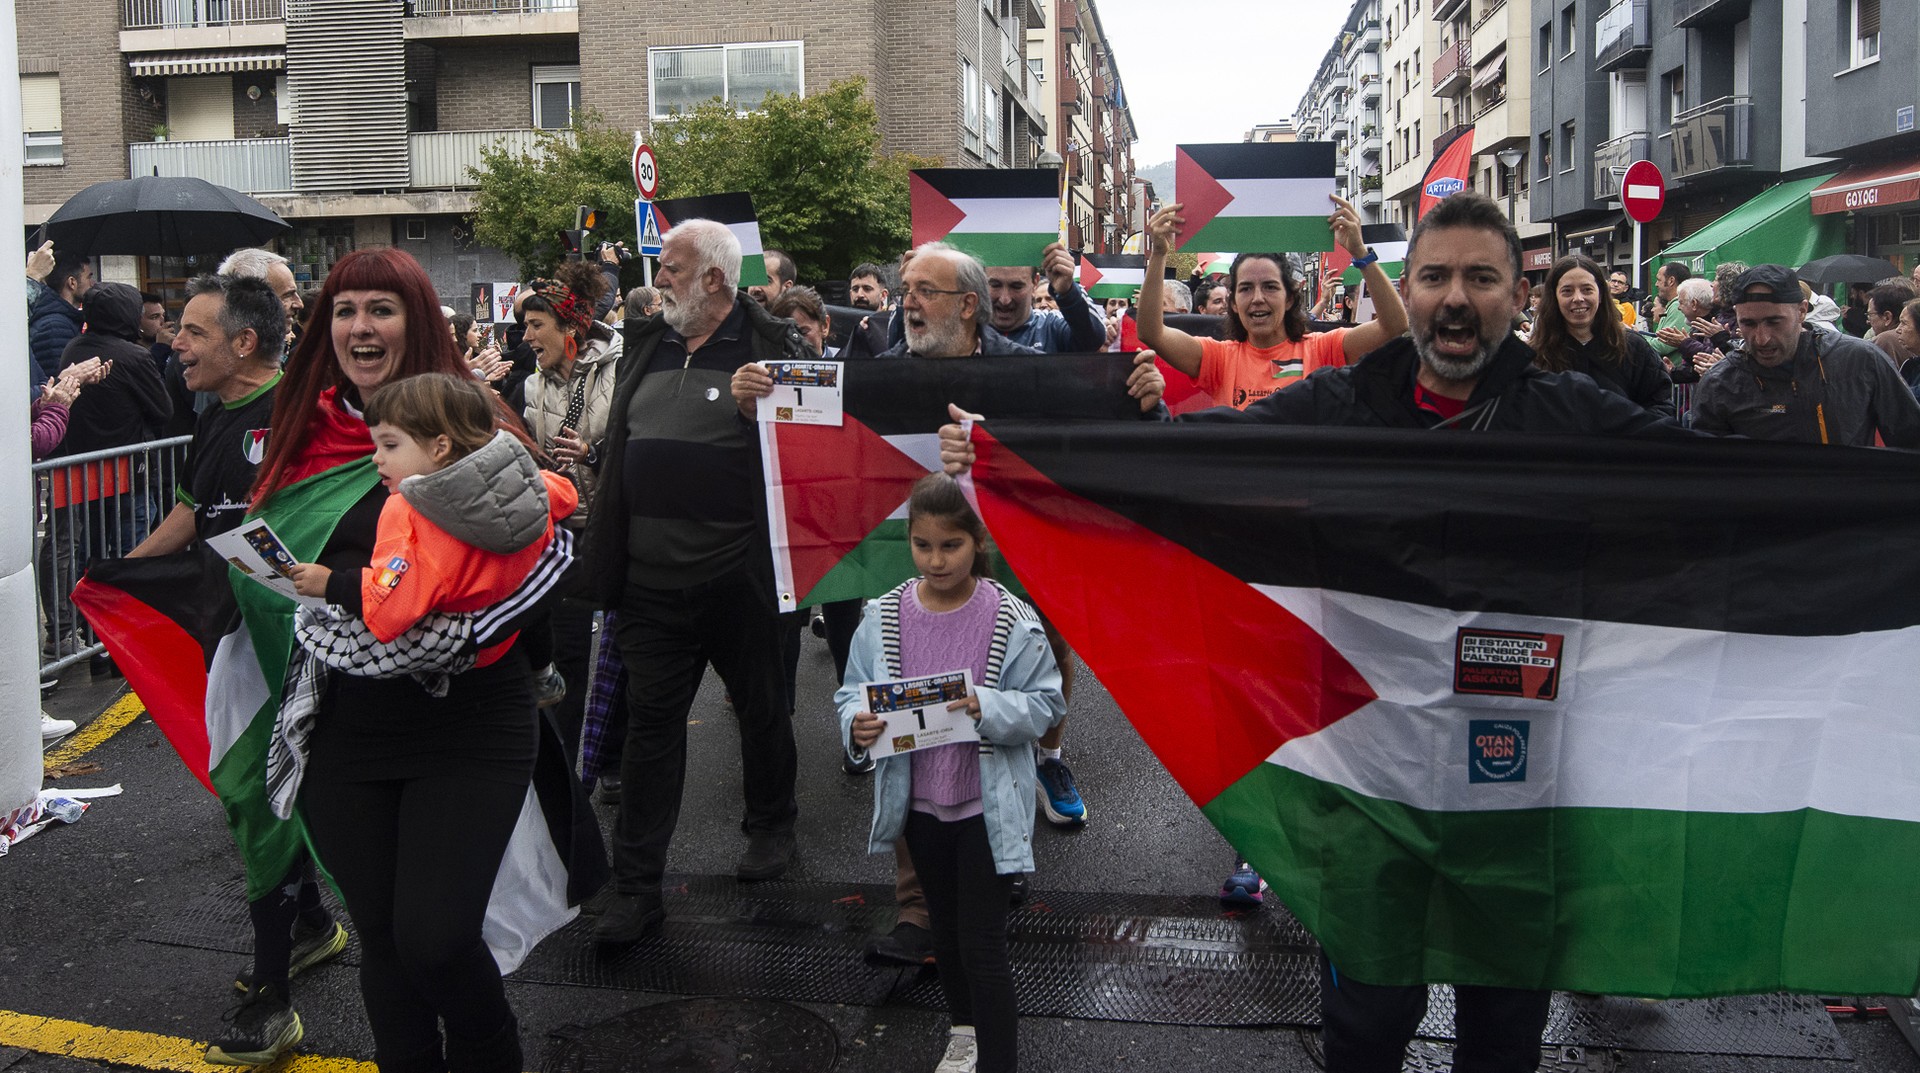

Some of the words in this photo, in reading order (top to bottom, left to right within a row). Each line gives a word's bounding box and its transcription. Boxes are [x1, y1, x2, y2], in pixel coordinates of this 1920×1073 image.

[641, 163, 653, 181] 30
[1845, 189, 1878, 207] GOXOGI
[793, 387, 803, 406] 1
[1464, 638, 1476, 646] BI
[1478, 638, 1543, 650] ESTATUEN
[1463, 645, 1529, 656] IRTENBIDE
[1463, 653, 1529, 664] FALTSUARI
[1531, 658, 1551, 666] EZ!
[1462, 667, 1519, 676] PALESTINA
[912, 708, 926, 730] 1
[1475, 735, 1515, 747] OTAN
[1483, 747, 1515, 758] NON
